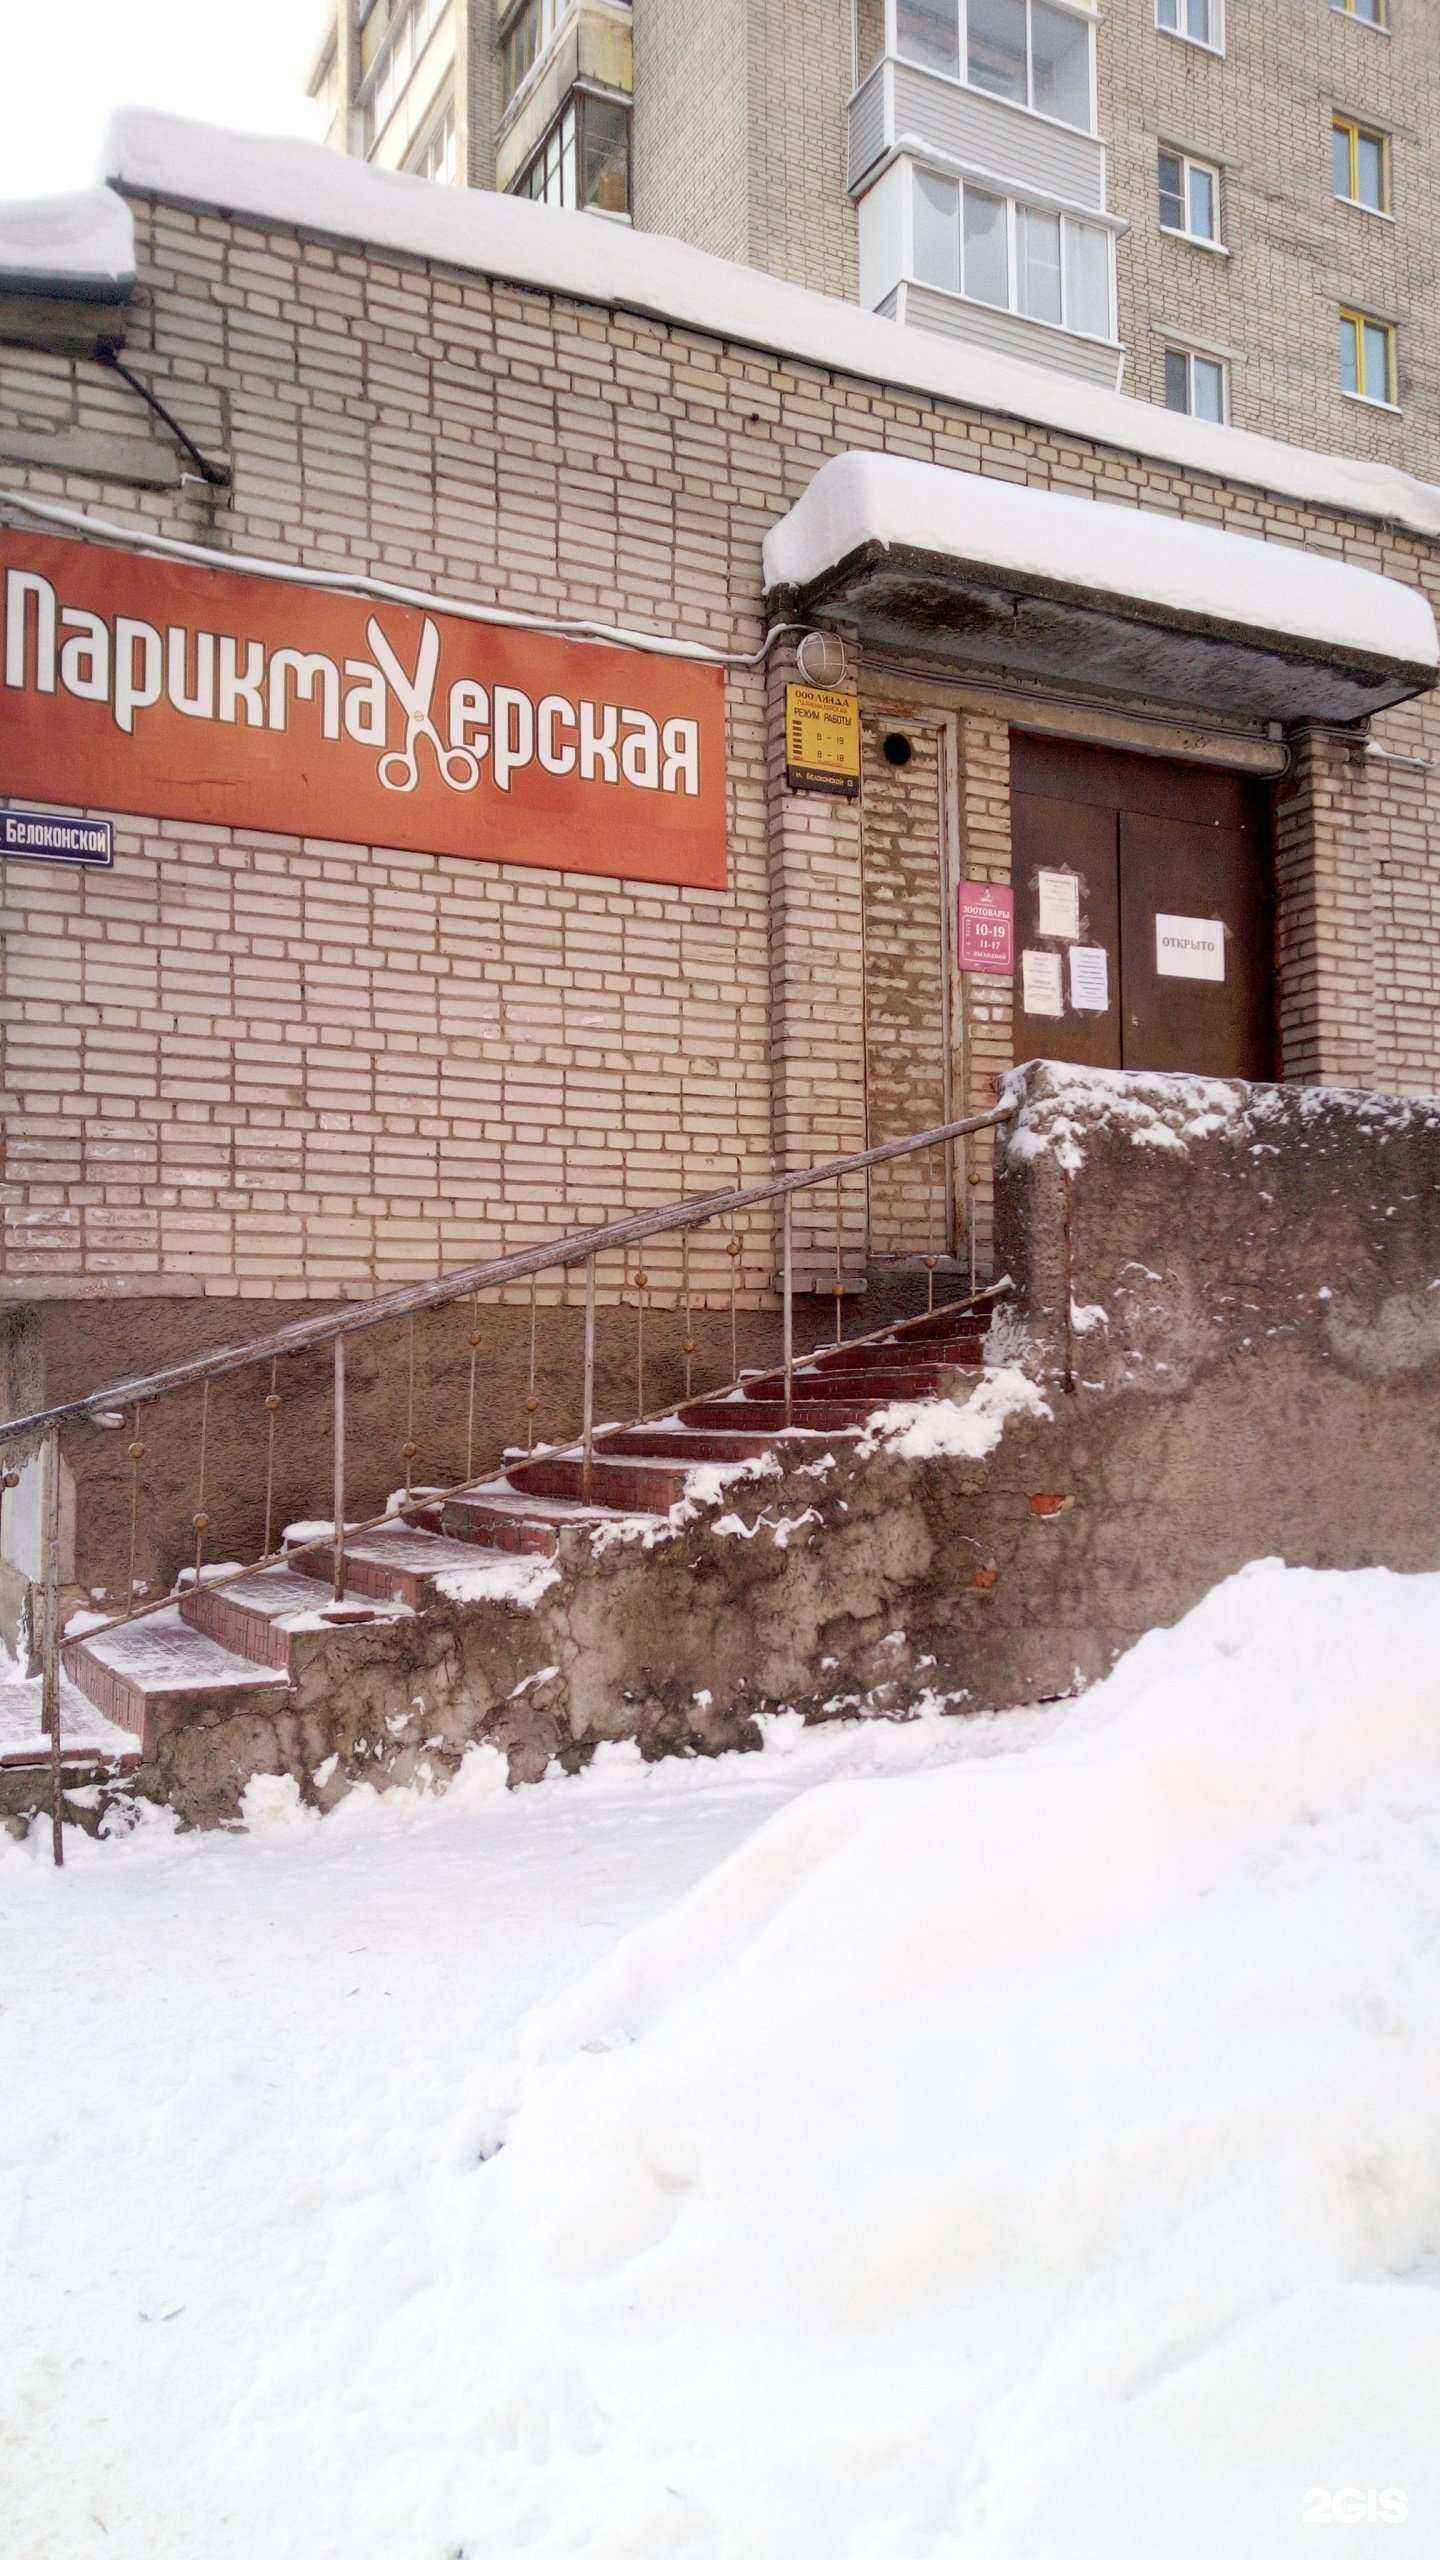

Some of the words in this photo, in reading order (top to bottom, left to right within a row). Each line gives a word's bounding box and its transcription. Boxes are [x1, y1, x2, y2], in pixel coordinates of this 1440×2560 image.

[795, 690, 814, 701] ООО
[794, 707, 820, 720] РЕЖИМ
[823, 712, 852, 726] РАБОТЫ
[6, 818, 106, 853] Белоконской
[963, 905, 1010, 919] ЗООТОВАРЫ
[975, 923, 1005, 938] 10-19
[1162, 936, 1215, 952] ОТКРЫТО
